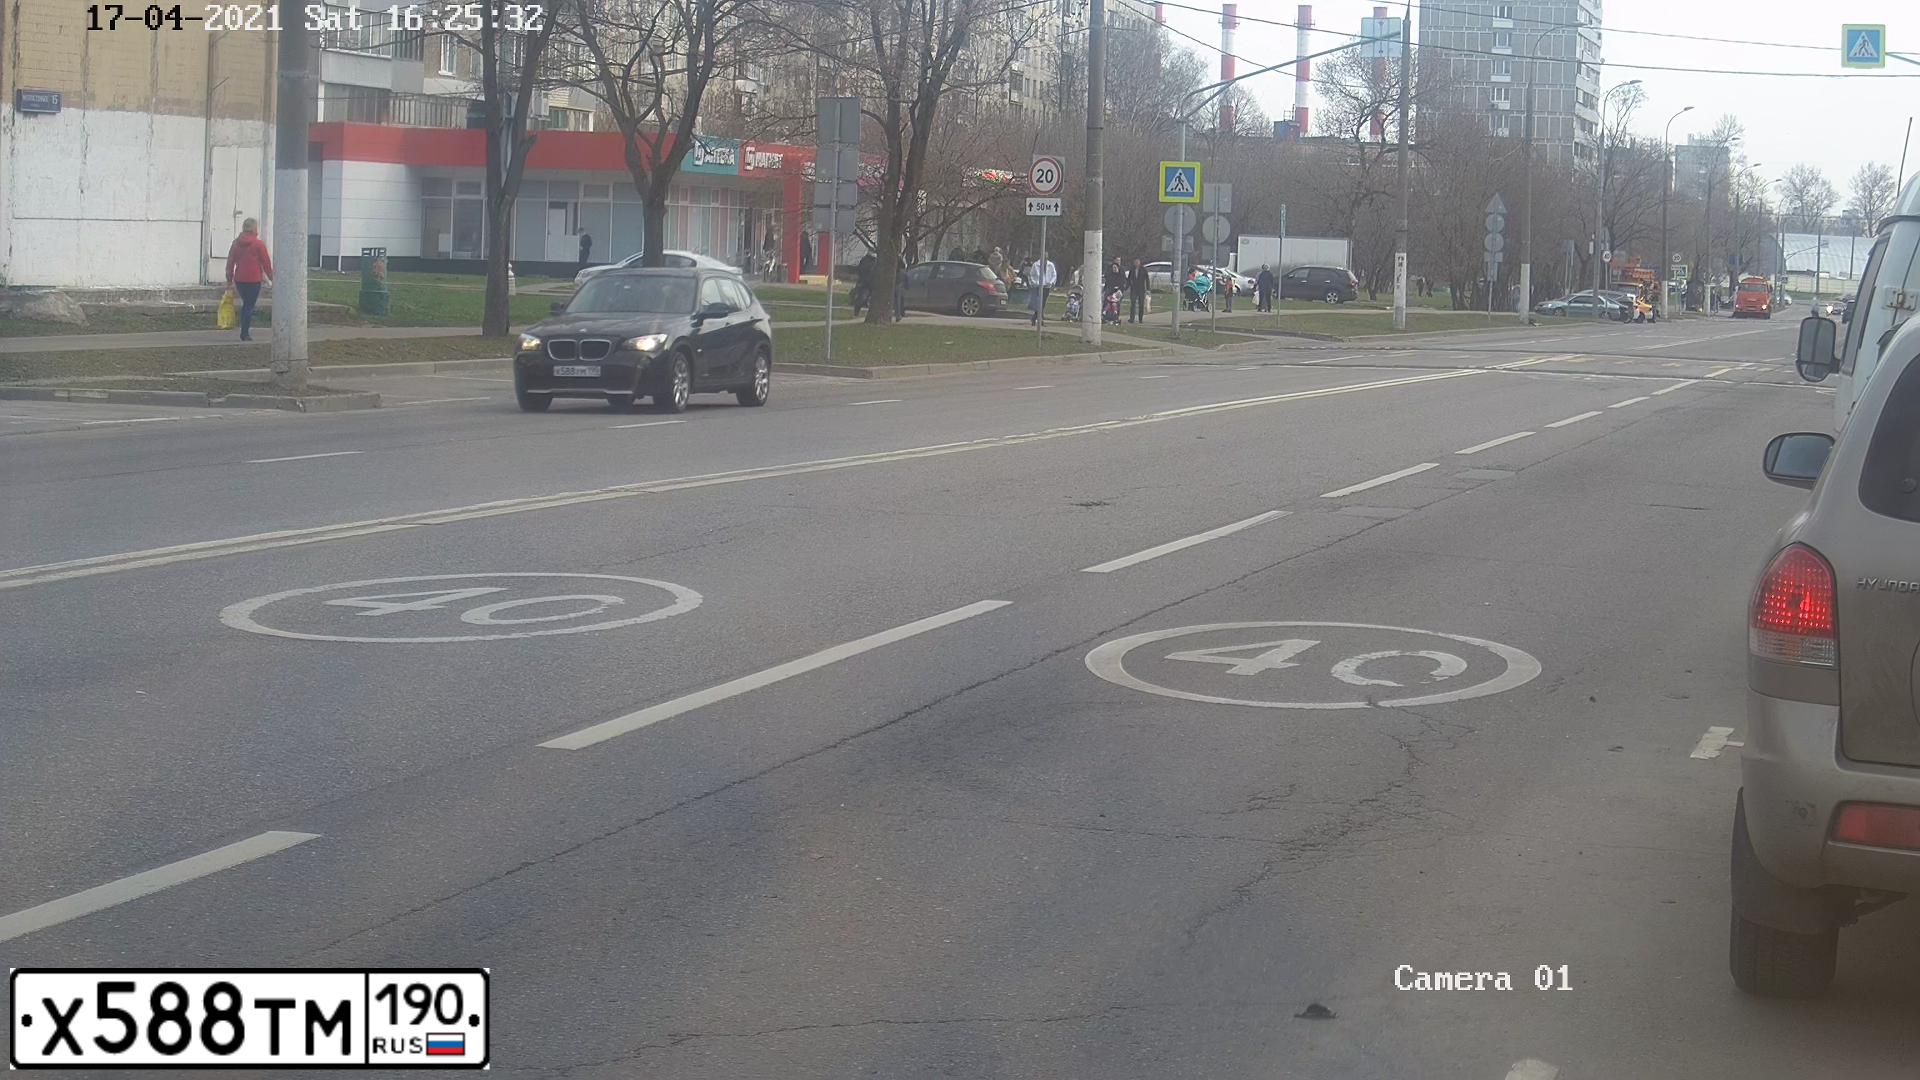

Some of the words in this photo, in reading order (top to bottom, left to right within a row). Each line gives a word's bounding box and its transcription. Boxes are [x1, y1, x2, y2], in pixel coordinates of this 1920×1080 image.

[51, 94, 59, 105] 15
[1035, 168, 1054, 184] 20
[322, 587, 625, 625] 40
[1164, 638, 1468, 687] 40
